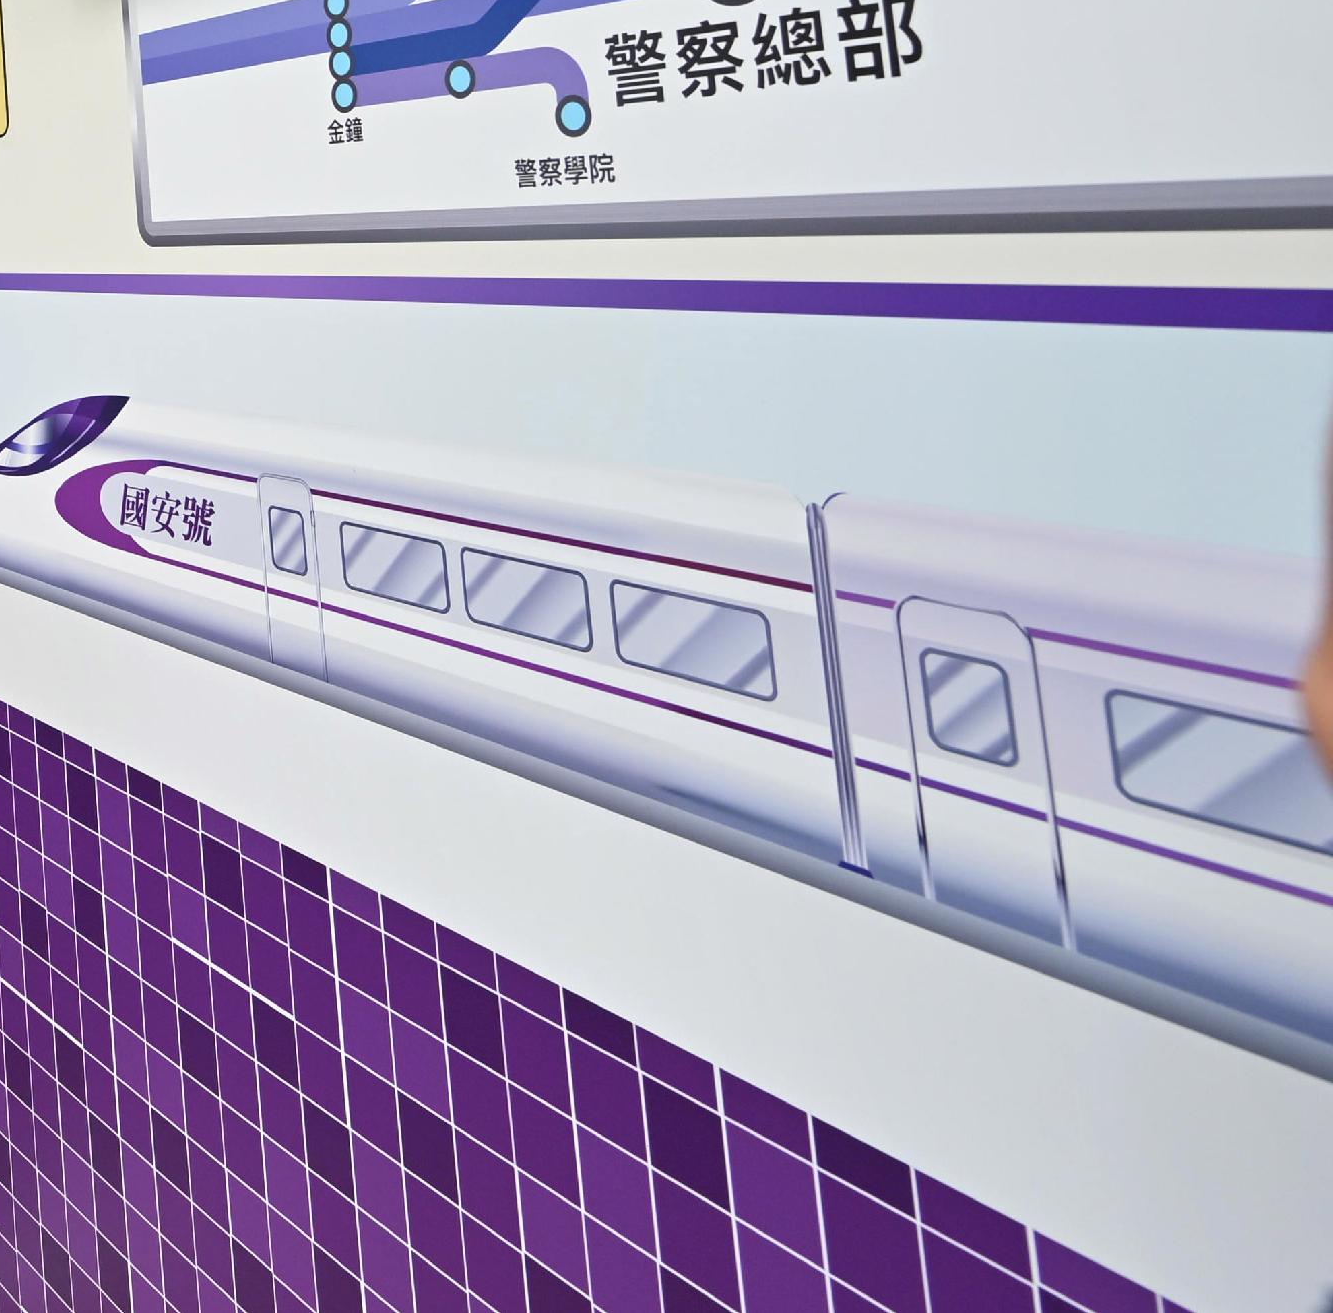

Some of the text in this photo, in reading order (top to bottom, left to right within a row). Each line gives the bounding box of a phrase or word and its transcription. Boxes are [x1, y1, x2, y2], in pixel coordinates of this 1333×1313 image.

[326, 117, 364, 145] 金鐘
[514, 152, 616, 188] 警察學院
[119, 483, 216, 547] 國安號
